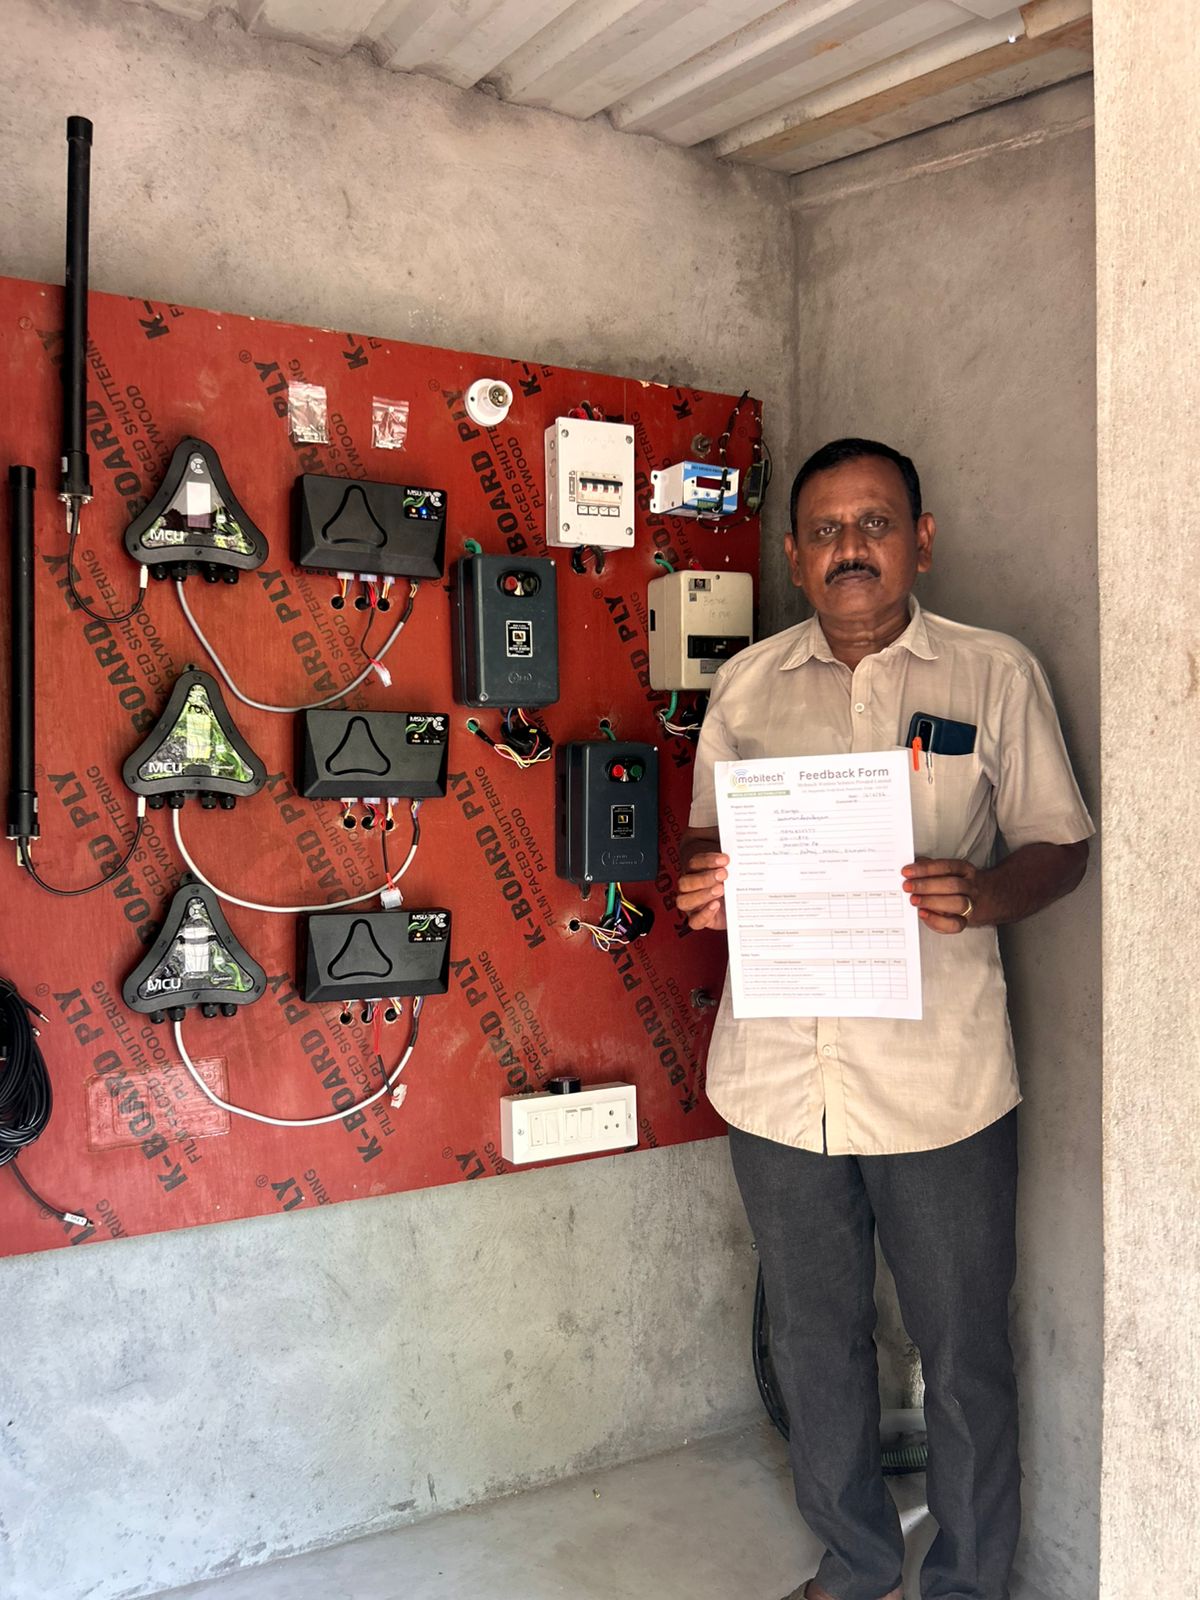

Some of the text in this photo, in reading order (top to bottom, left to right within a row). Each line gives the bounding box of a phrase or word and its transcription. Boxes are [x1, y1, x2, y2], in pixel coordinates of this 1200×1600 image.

[138, 298, 170, 341] K-
[343, 334, 369, 370] K-
[519, 362, 542, 397] K-
[86, 400, 149, 519] BOARD
[331, 412, 367, 479] LYWOOD
[485, 425, 517, 481] SHUTTE
[498, 436, 544, 509] PLYWOOD
[471, 450, 528, 555] BOARD
[510, 483, 538, 533] FACED
[150, 529, 184, 541] MCU
[257, 570, 301, 624] PLY
[604, 595, 637, 644] PLY
[82, 618, 158, 734] BOARD
[136, 652, 168, 697] ACED
[149, 762, 182, 773] MCU
[738, 773, 784, 784] mobitech
[799, 768, 889, 780] Feedback Form
[47, 770, 160, 945] BOARD PLY
[448, 770, 546, 950] K-BOARD PLY
[474, 765, 558, 928] FILM FACED SHUTTERING
[511, 807, 548, 873] PLYWOOD
[147, 978, 181, 991] MCU
[450, 956, 488, 1008] PLY
[666, 977, 699, 1038] PLYWOOD
[91, 980, 151, 1076] SHUTTERING
[478, 951, 549, 1079] FACED SHUTTERING
[514, 991, 553, 1057] PLYWOOD
[139, 1026, 188, 1100] PLYWOOD
[347, 1058, 375, 1100] ACED
[635, 995, 698, 1114] K-BOARD
[53, 988, 188, 1192] K-BOARD PLY
[300, 1029, 384, 1164] K-BOARD
[371, 1103, 396, 1137] FILM
